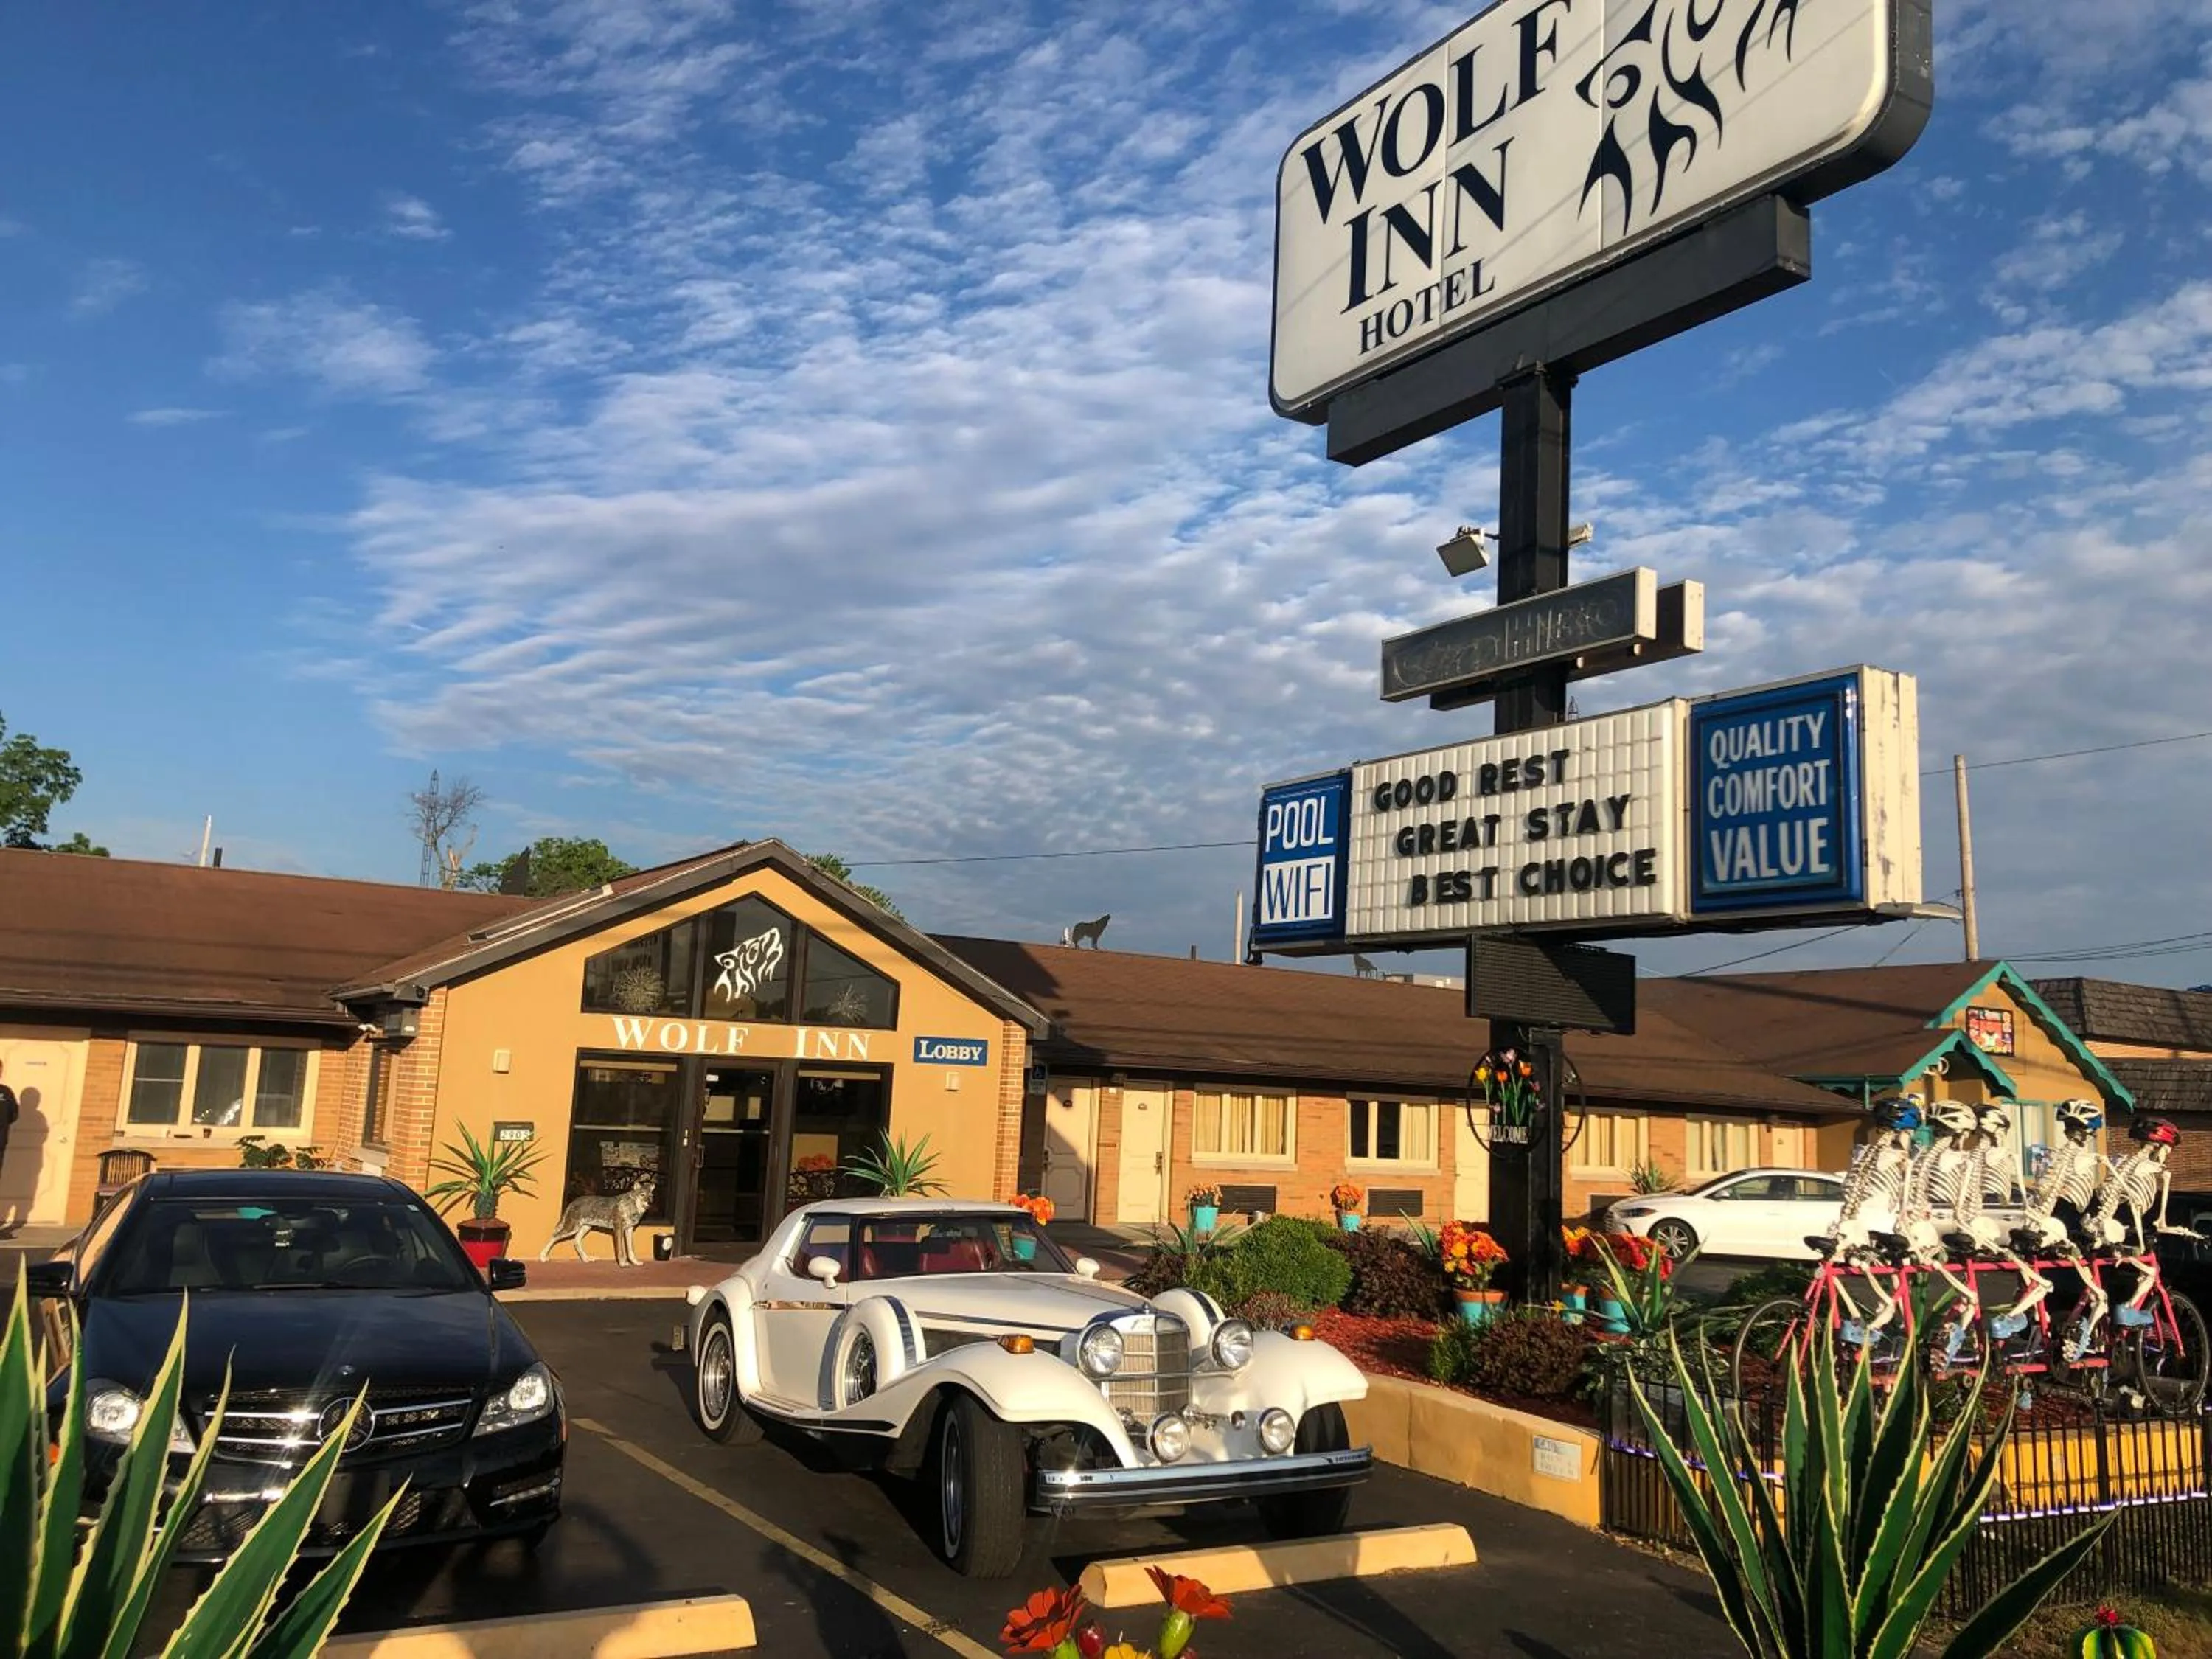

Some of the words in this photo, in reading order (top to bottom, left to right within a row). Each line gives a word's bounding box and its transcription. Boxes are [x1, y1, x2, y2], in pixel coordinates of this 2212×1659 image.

[1300, 0, 1571, 224] WOLF
[1340, 137, 1514, 315] INN
[1358, 259, 1495, 355] HOTEL
[1710, 712, 1826, 769] QUALITY
[1374, 771, 1457, 811] GOOD
[1479, 749, 1570, 796] REST
[1708, 759, 1830, 818] COMFORT
[1265, 796, 1334, 853] POOL
[1395, 814, 1501, 856] GREAT
[1526, 794, 1631, 841] STAY
[1710, 818, 1829, 882] VALUE
[1266, 863, 1331, 919] WIFI
[1411, 866, 1498, 906] BEST
[1519, 848, 1657, 896] CHOICE
[612, 1018, 749, 1054] WOLF
[794, 1027, 870, 1060] INN
